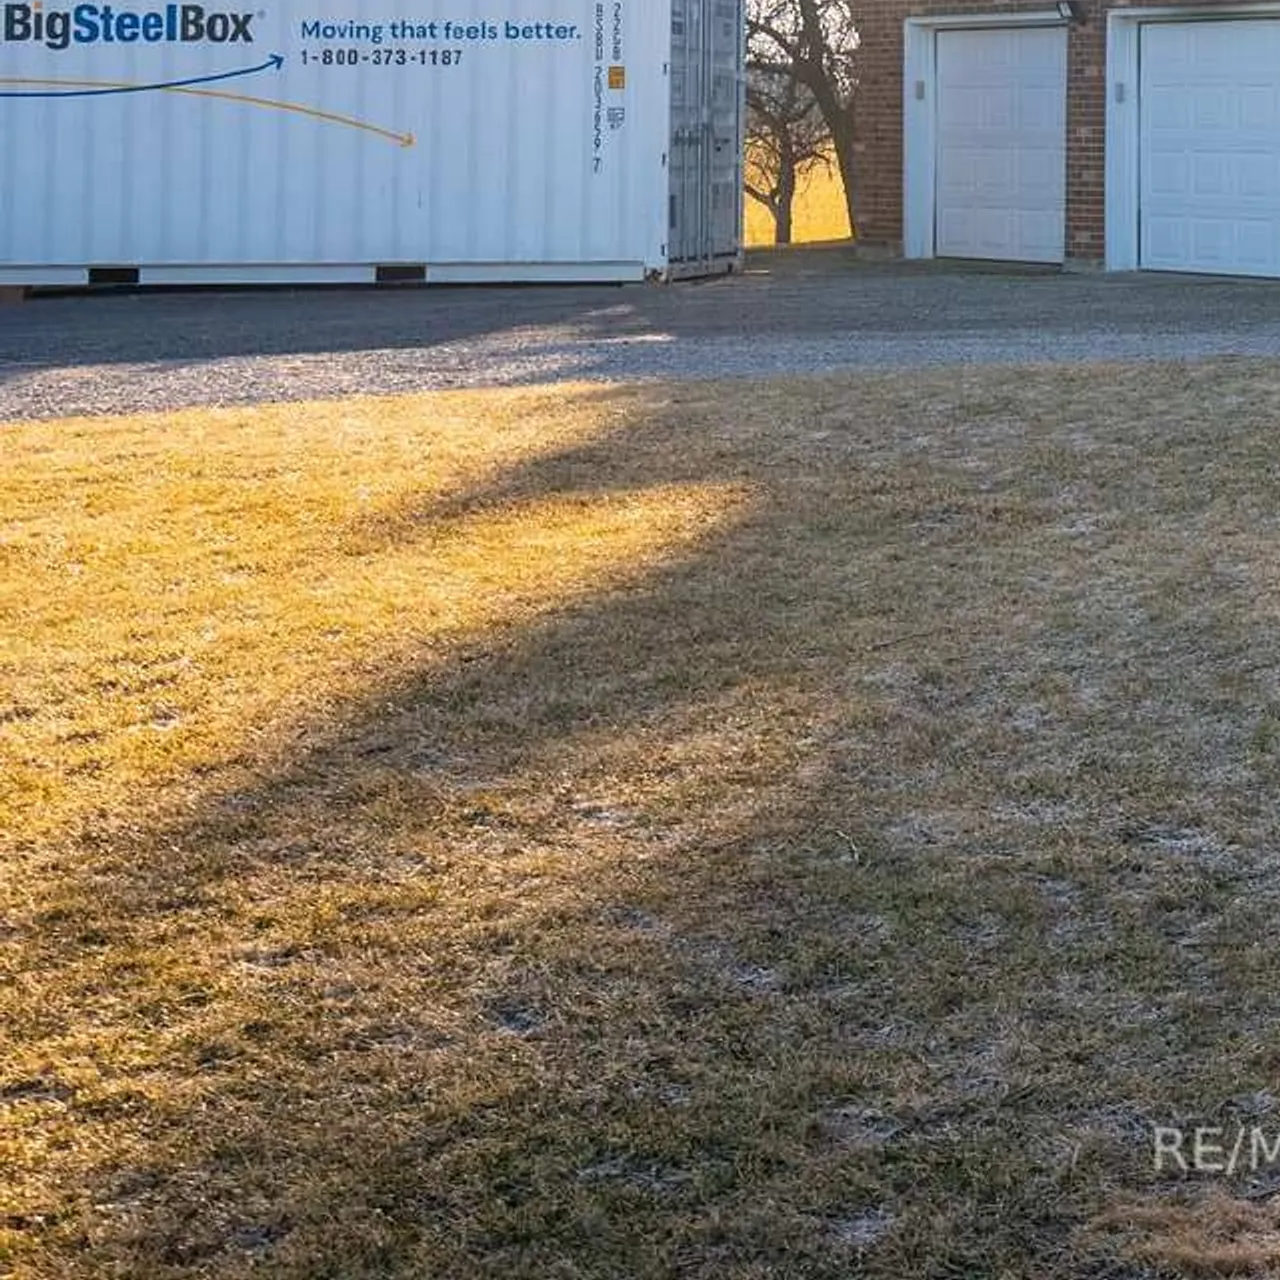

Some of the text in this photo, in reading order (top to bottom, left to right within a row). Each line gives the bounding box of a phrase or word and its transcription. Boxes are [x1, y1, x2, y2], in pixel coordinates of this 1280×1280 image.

[3, 1, 254, 50] BigSteelBox
[301, 20, 581, 43] Moving that feels better.
[301, 49, 463, 66] 1-800-373-1187
